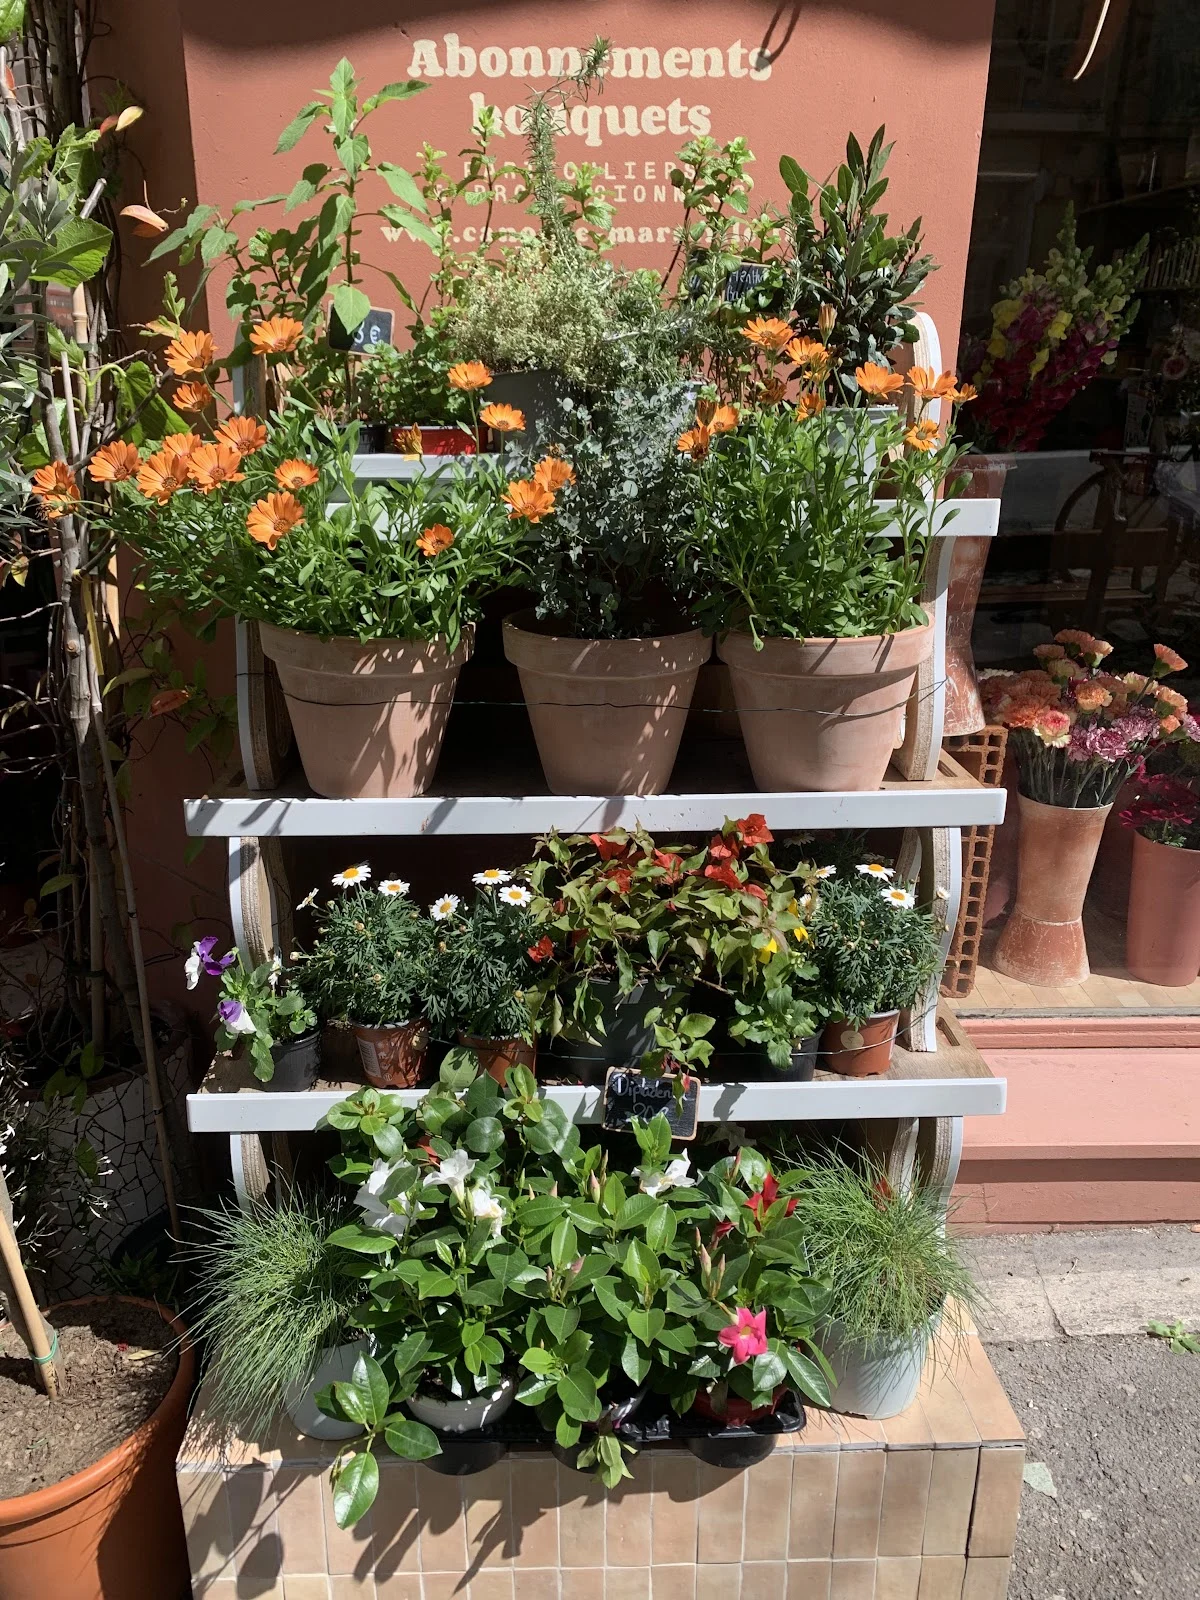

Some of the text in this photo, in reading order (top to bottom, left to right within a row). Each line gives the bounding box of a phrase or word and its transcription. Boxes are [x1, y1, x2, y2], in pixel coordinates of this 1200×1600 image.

[407, 33, 772, 81] Abonnements
[463, 161, 697, 180] PARTCLIERS
[611, 1072, 689, 1104] Dipladen
